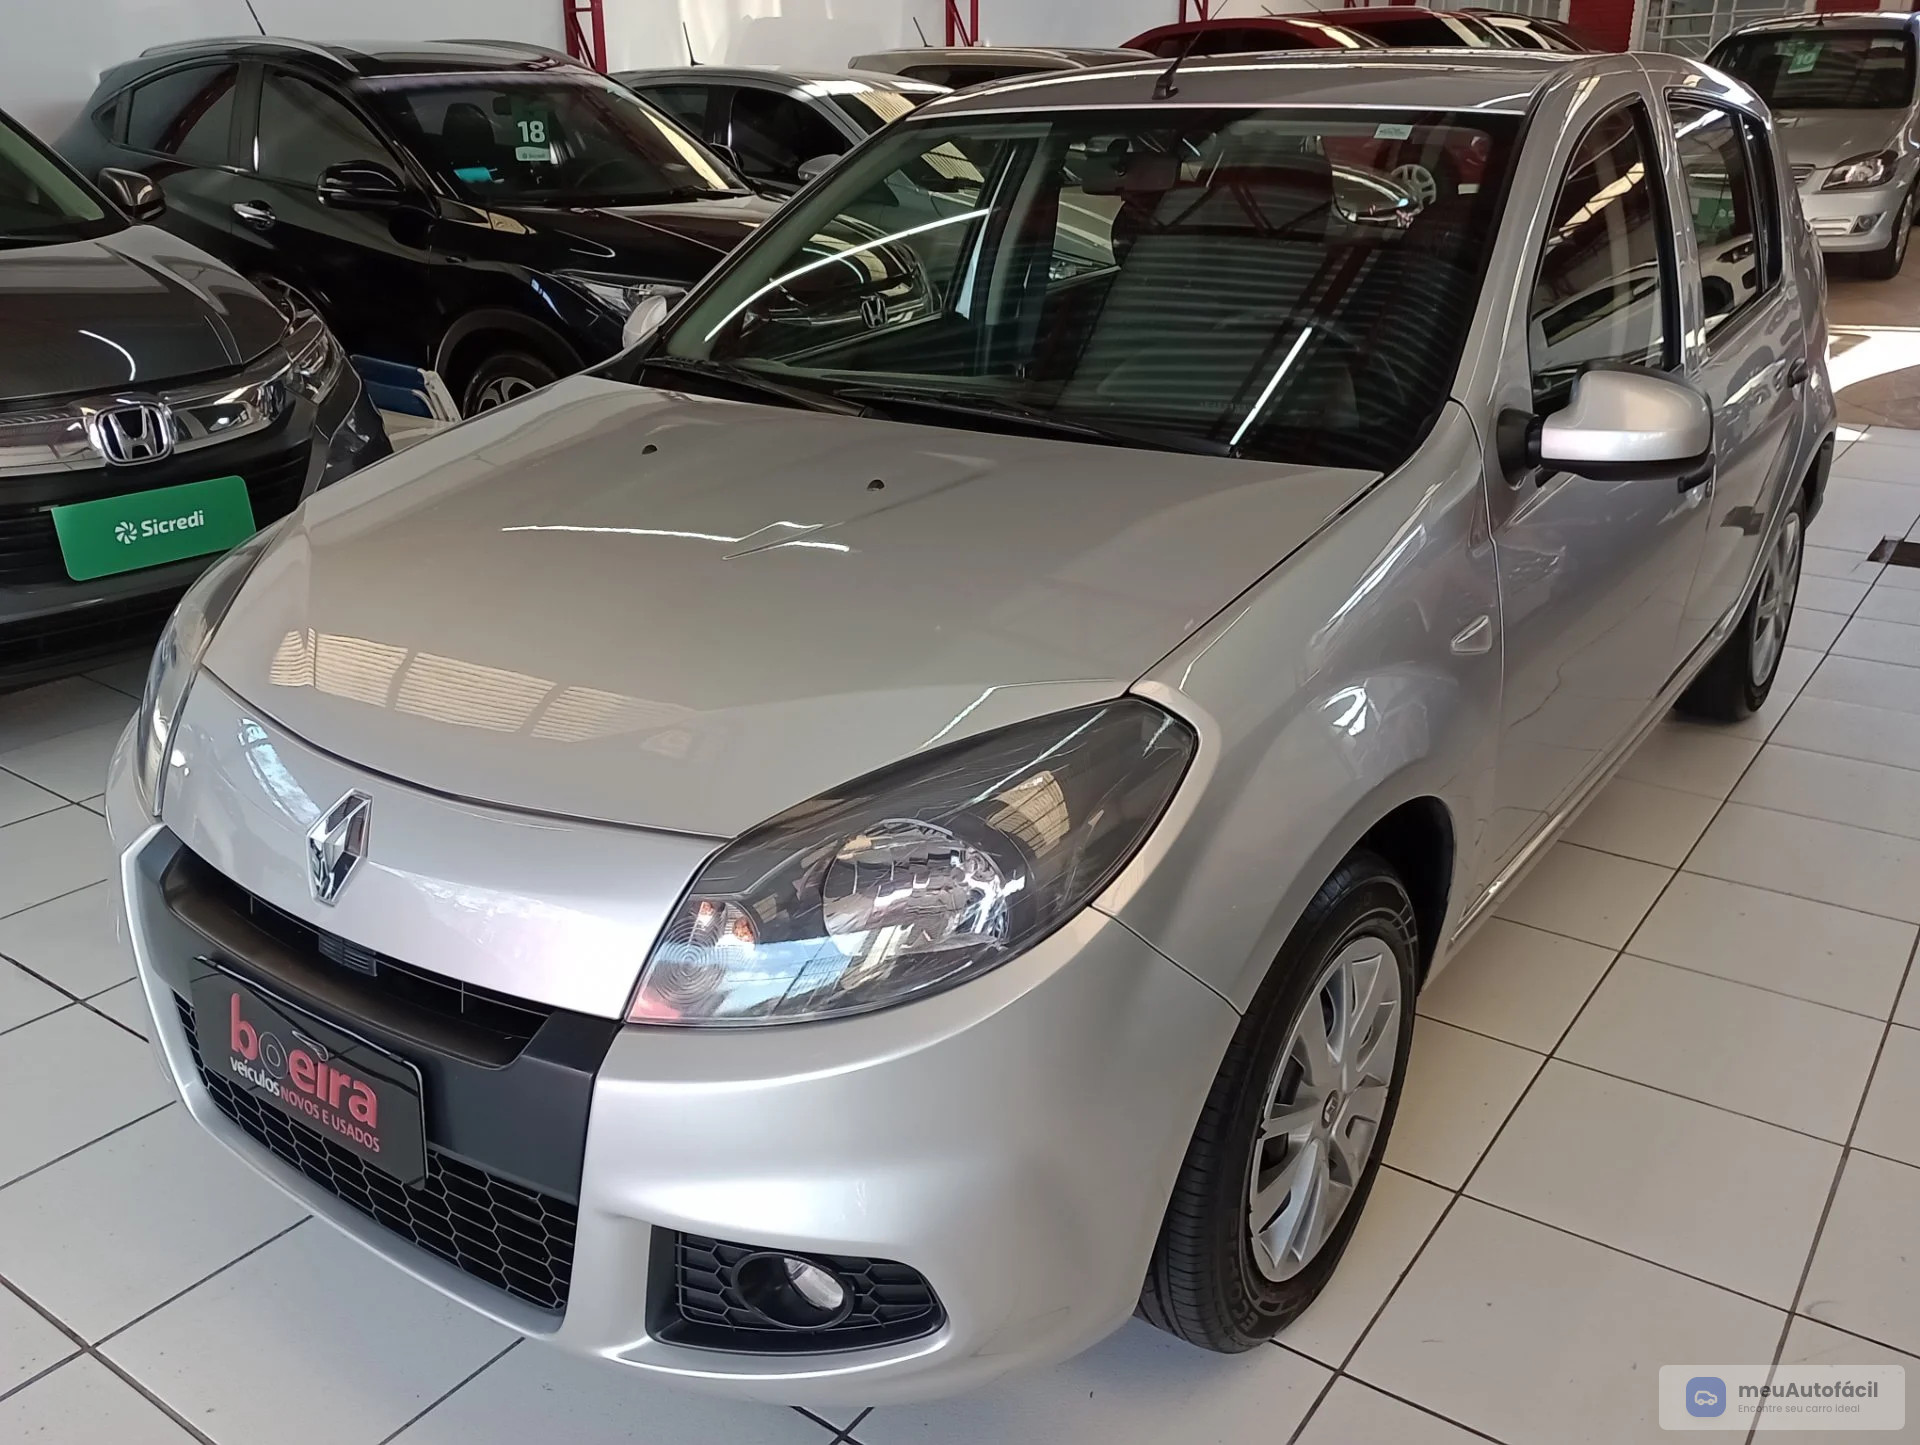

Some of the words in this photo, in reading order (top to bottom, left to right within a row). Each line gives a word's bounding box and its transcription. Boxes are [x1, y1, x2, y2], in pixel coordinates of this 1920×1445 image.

[517, 120, 546, 143] 18
[140, 510, 205, 537] Sicredi
[231, 992, 378, 1129] boeira
[230, 1056, 280, 1097] veículos
[280, 1085, 320, 1120] NOVOS
[322, 1109, 330, 1125] E
[331, 1115, 380, 1153] USADOS
